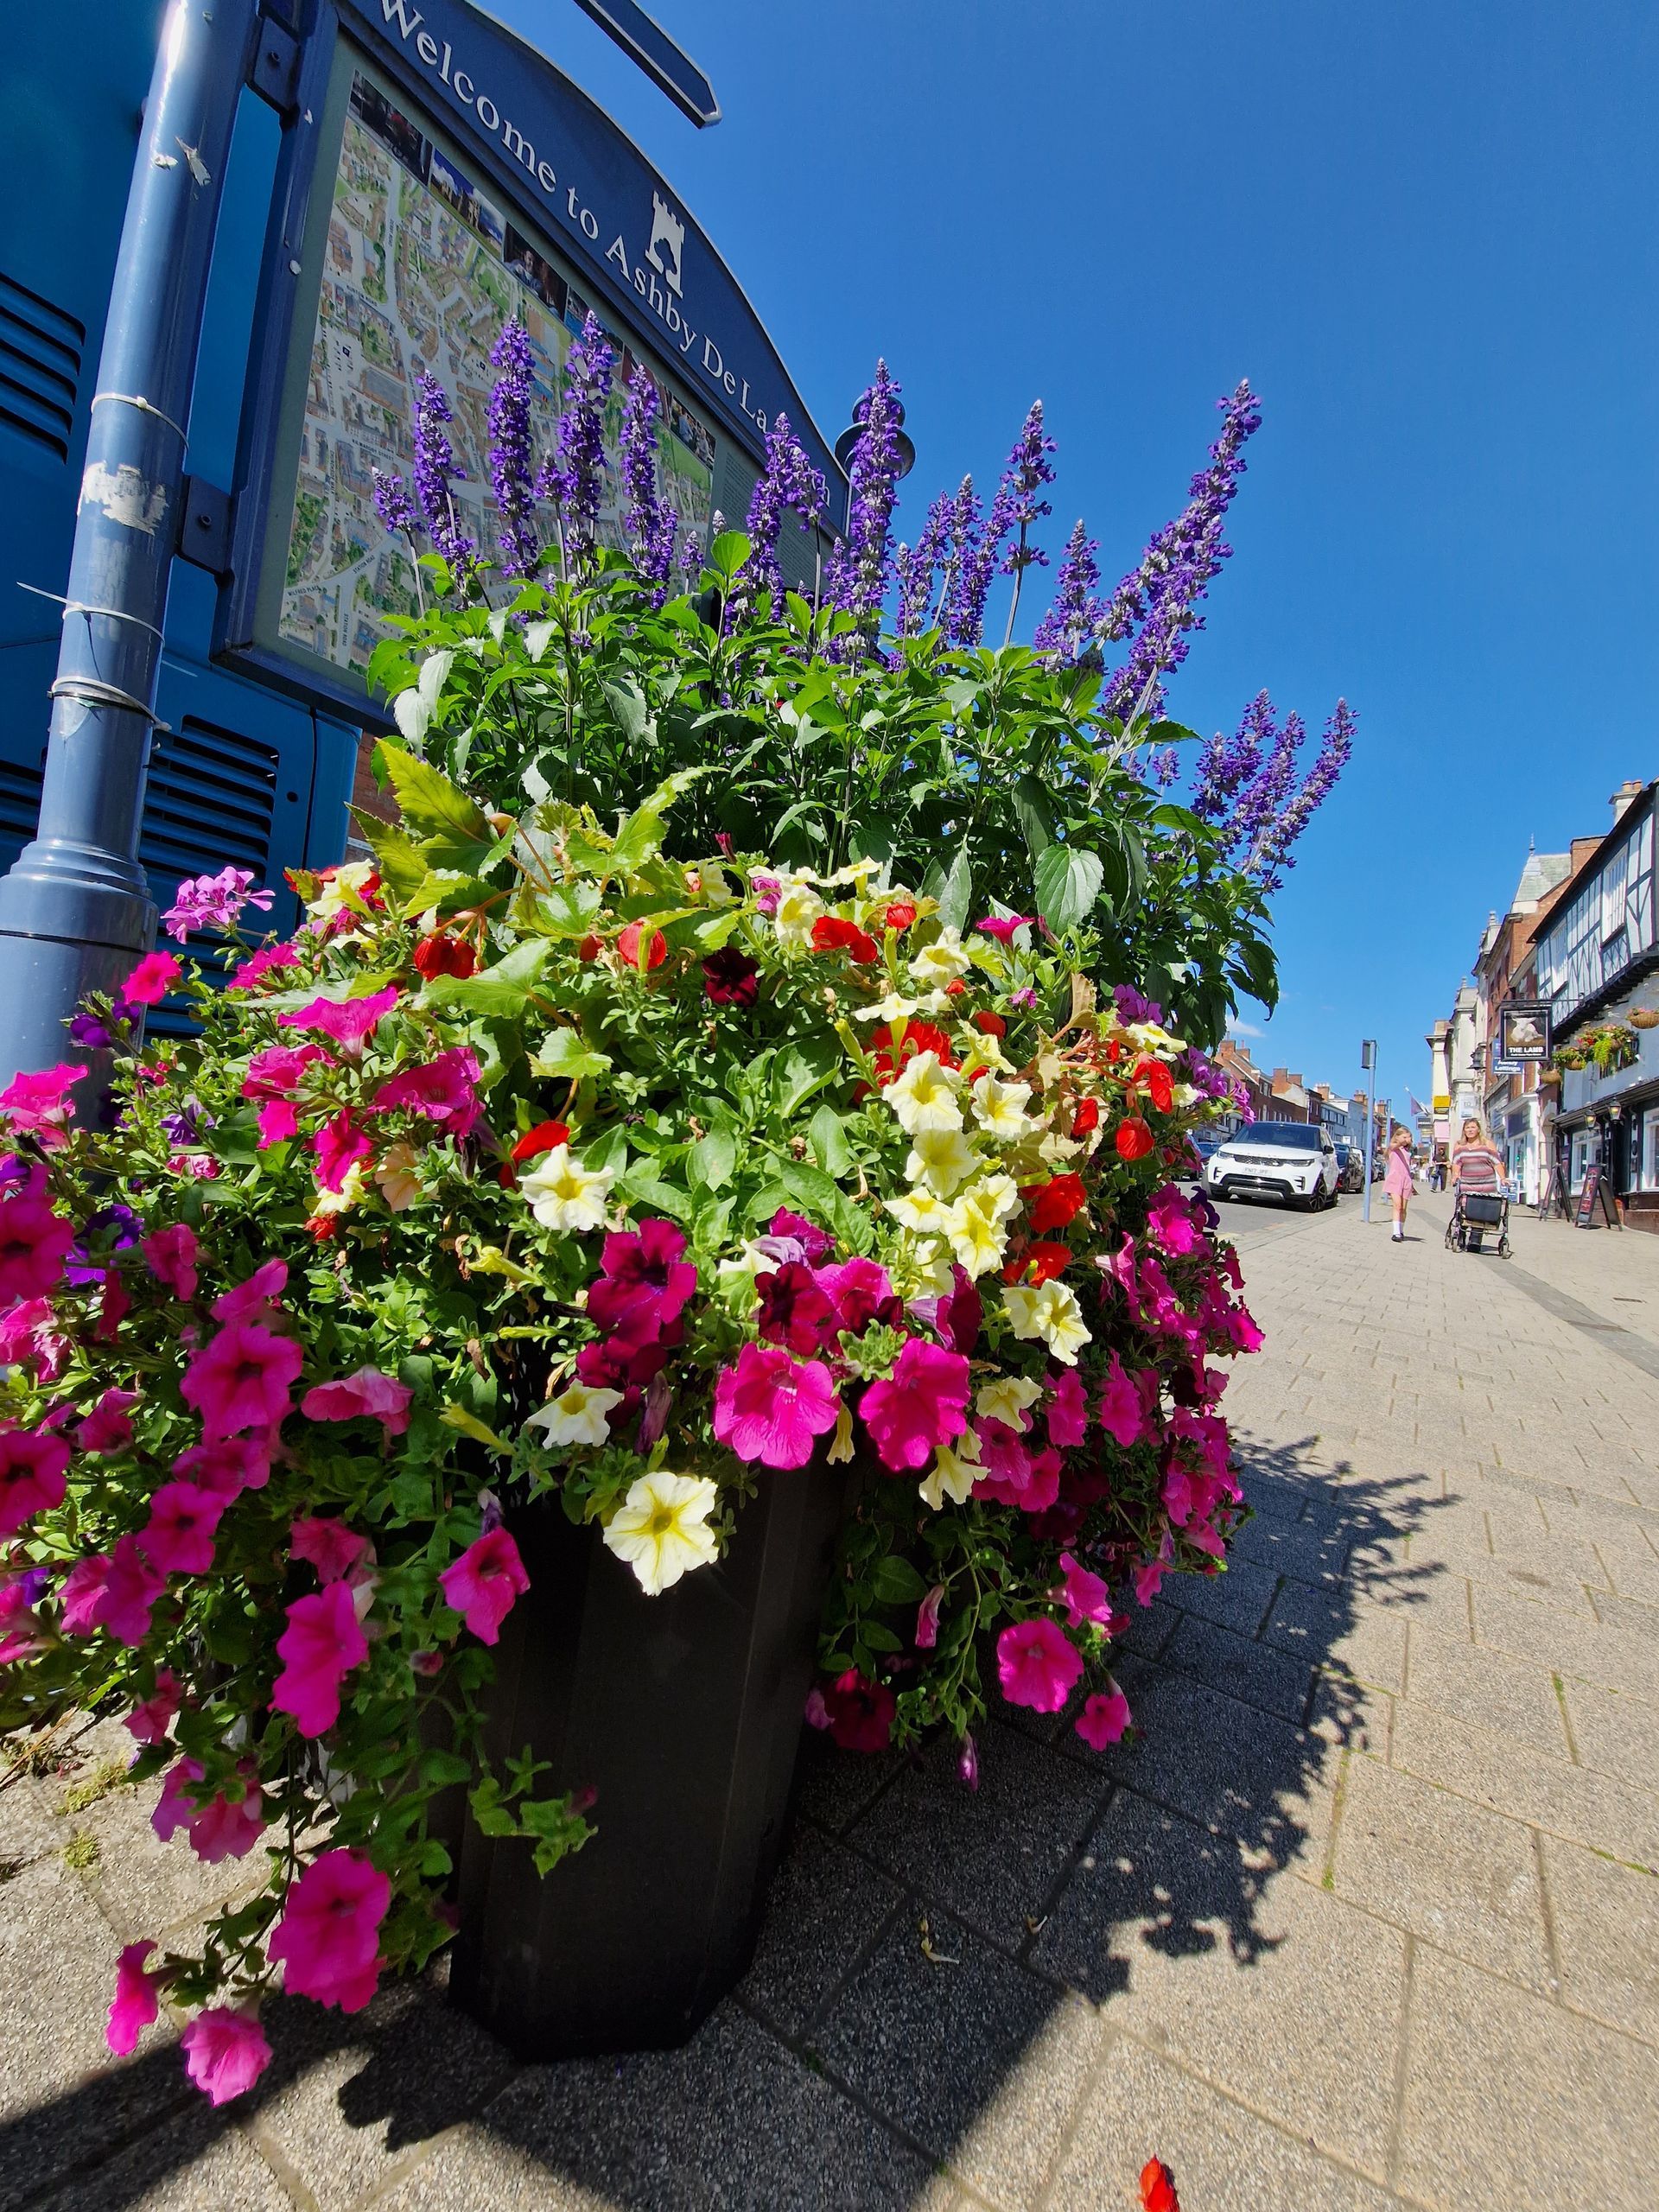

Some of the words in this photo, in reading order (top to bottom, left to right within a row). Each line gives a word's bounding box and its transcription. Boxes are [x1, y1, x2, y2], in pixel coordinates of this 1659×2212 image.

[380, 0, 556, 193] Welcome
[567, 186, 598, 240] to
[604, 234, 697, 353] Ashby
[701, 334, 735, 395] De
[740, 378, 768, 434] La
[353, 562, 367, 575] STATION
[287, 587, 306, 596] WILFRED
